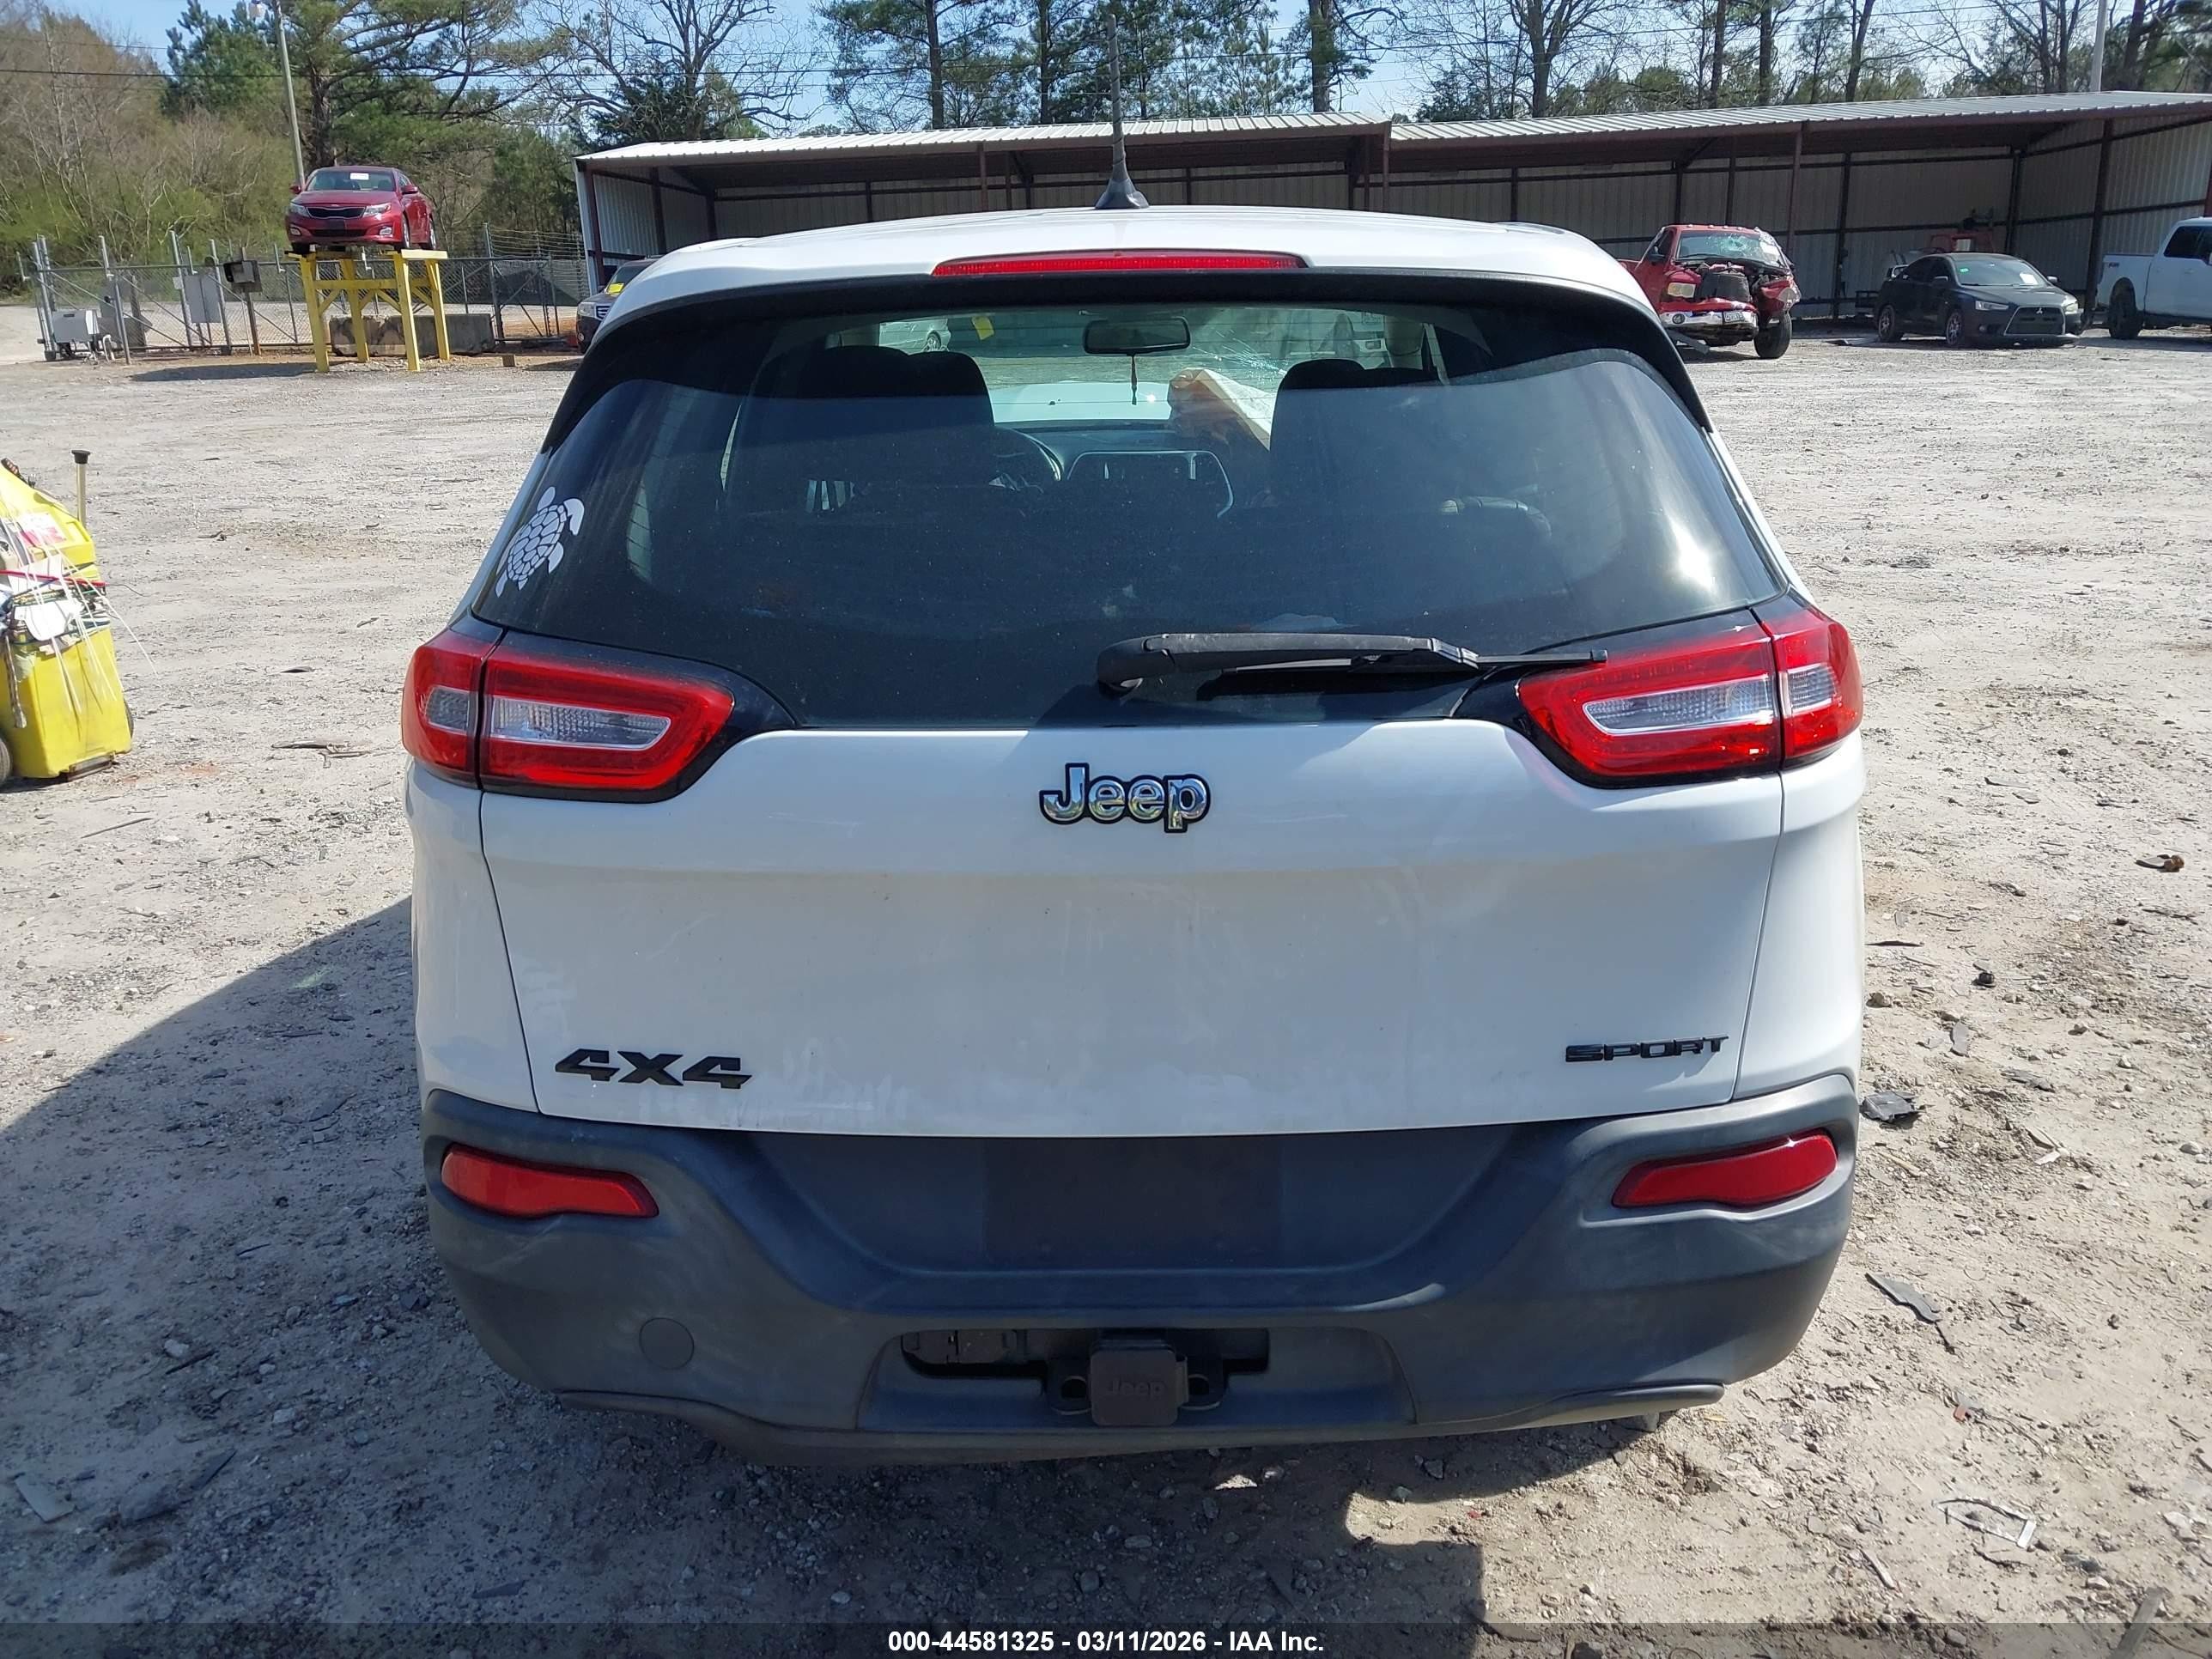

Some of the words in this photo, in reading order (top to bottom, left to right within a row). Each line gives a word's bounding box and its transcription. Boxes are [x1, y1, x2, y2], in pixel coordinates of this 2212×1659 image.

[1040, 763, 1211, 832] Jeep
[1565, 1036, 1729, 1062] SPORT
[556, 1048, 752, 1089] 4X4
[1105, 1376, 1166, 1401] Jeep
